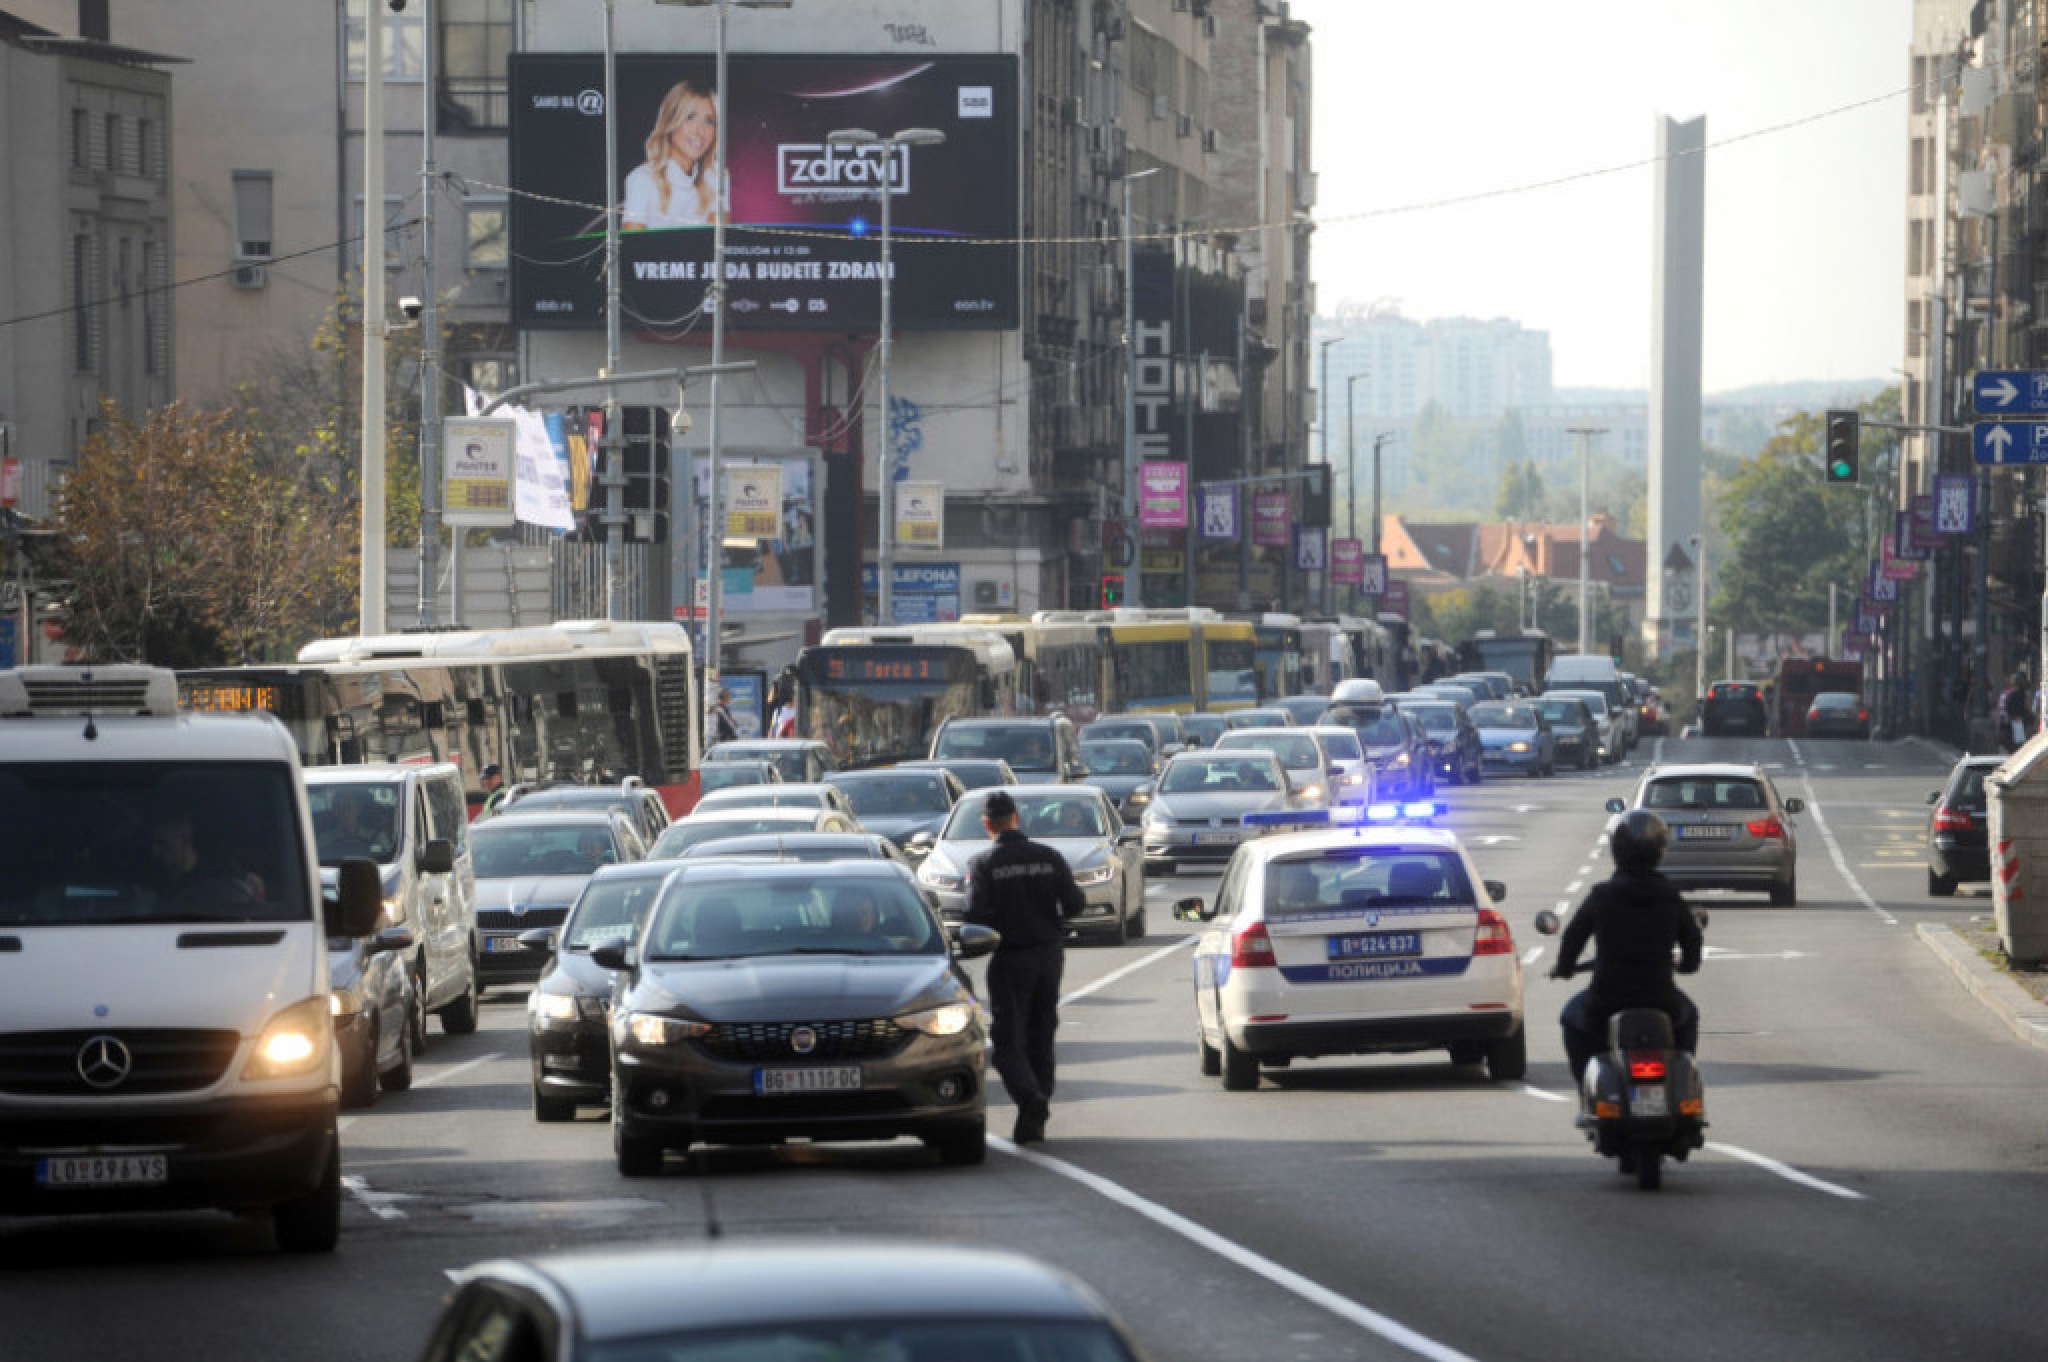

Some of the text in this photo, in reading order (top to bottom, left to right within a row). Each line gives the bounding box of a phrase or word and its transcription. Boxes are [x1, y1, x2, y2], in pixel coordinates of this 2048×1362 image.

[790, 144, 898, 182] zdravi
[633, 261, 697, 279] VREME
[725, 261, 751, 279] DA
[756, 261, 822, 279] BUDETE
[1328, 960, 1422, 980] ПОЛИЦИЈА
